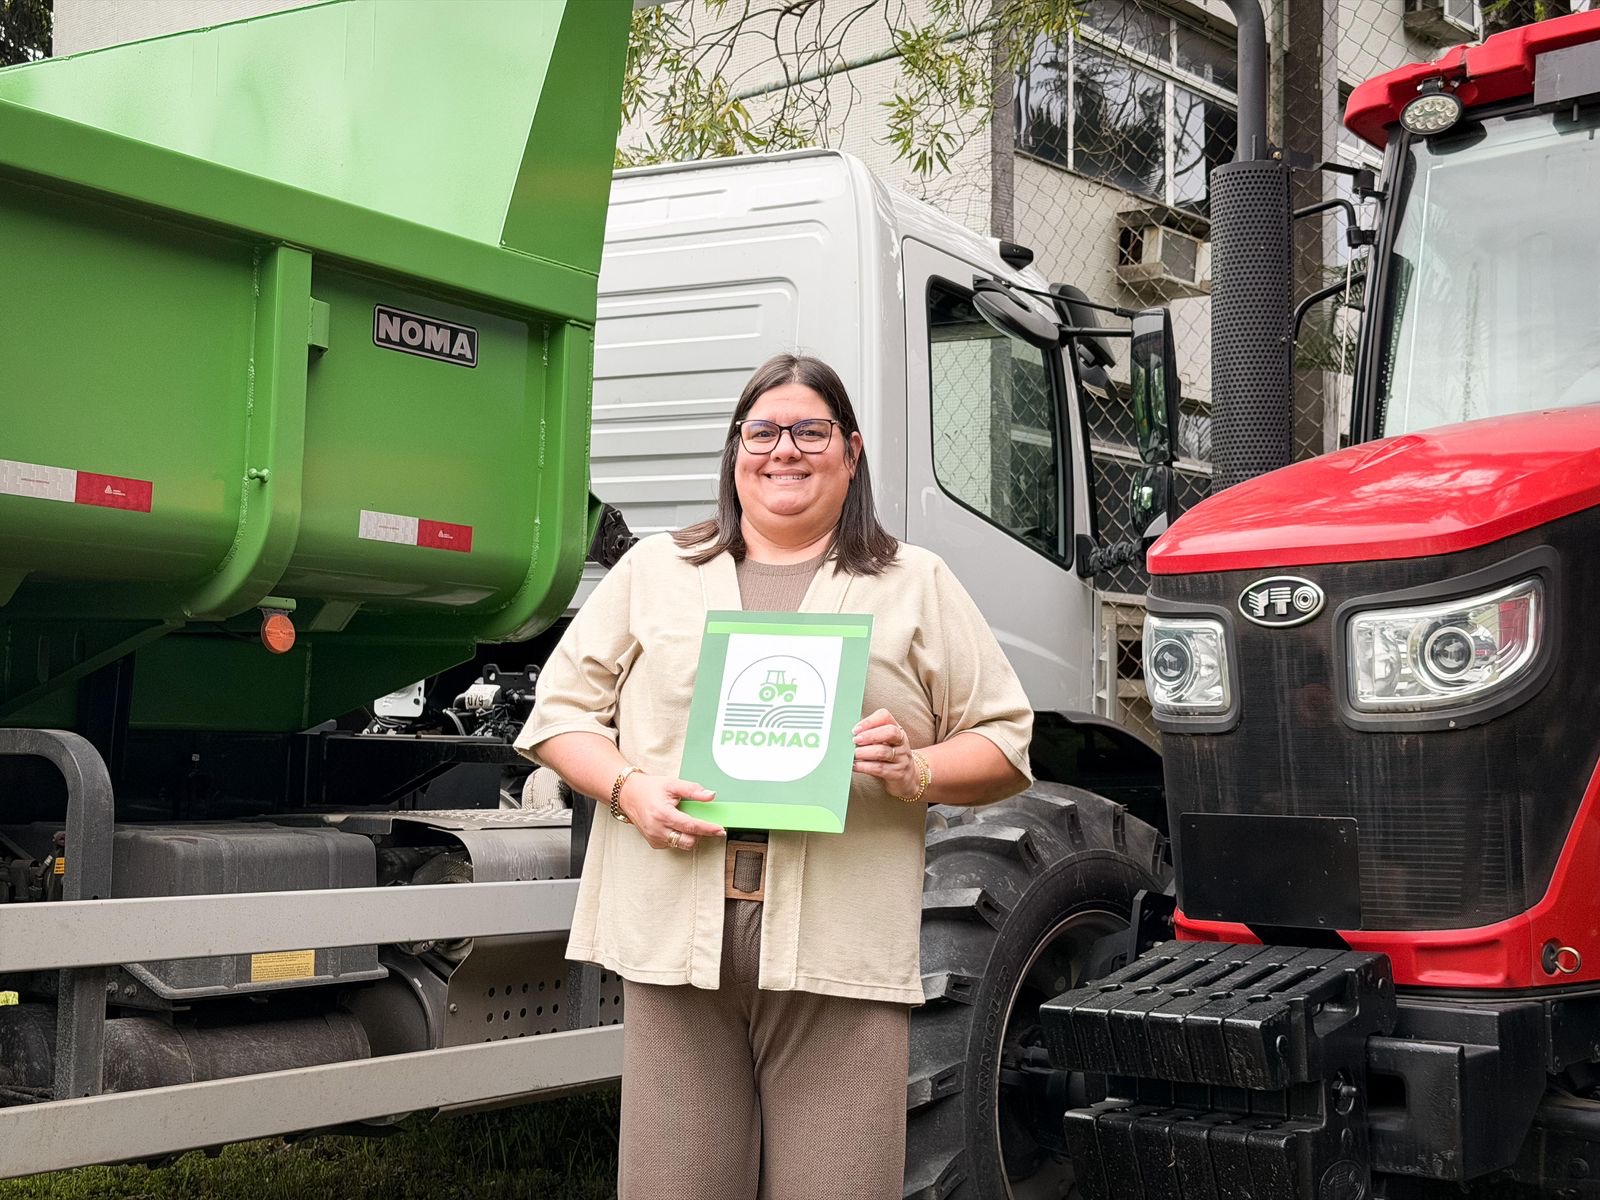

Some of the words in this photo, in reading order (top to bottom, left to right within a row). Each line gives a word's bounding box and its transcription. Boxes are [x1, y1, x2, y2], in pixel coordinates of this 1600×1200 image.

[378, 312, 473, 360] NOMA
[720, 730, 820, 748] PROMAQ
[977, 965, 1010, 1122] ARMOUR
